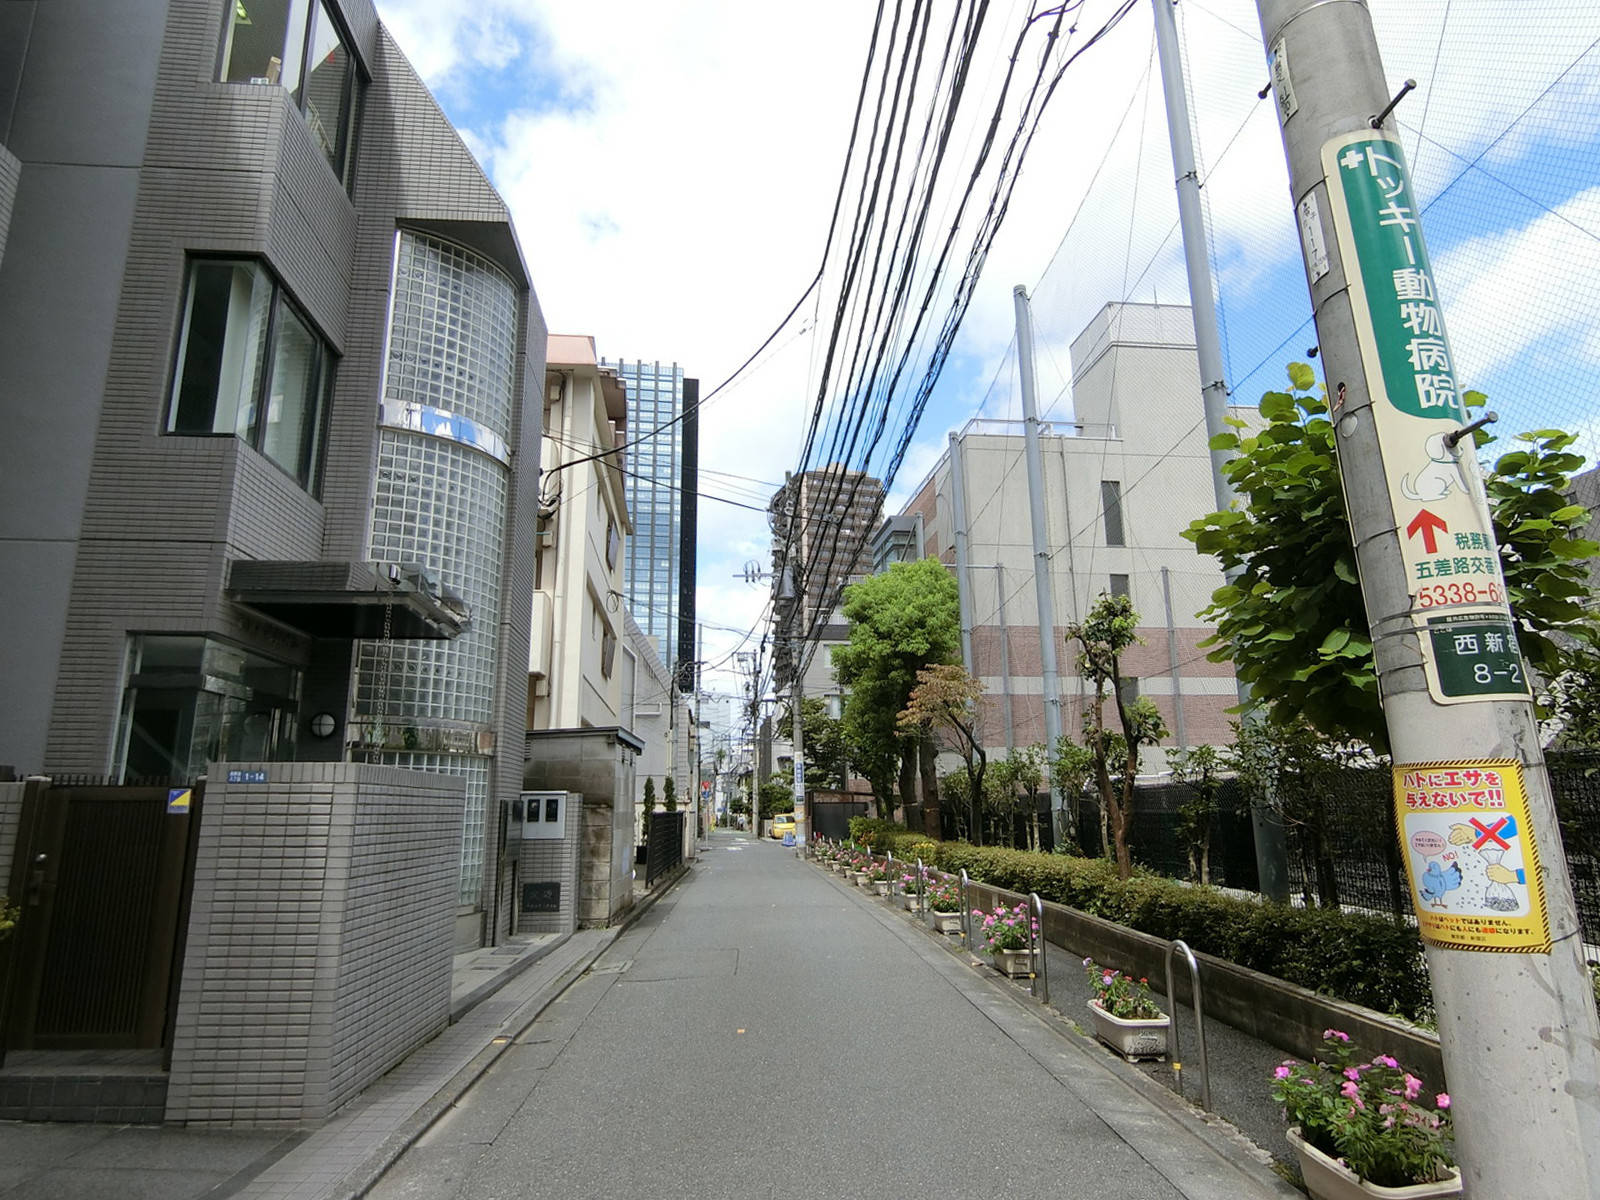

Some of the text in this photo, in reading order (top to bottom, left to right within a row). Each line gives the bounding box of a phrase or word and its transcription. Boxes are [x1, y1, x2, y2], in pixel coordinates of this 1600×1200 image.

[1453, 631, 1519, 655] 西新宿
[1473, 663, 1521, 683] 8-2
[1402, 769, 1500, 788] ハトにエサを
[1442, 851, 1459, 861] NO!
